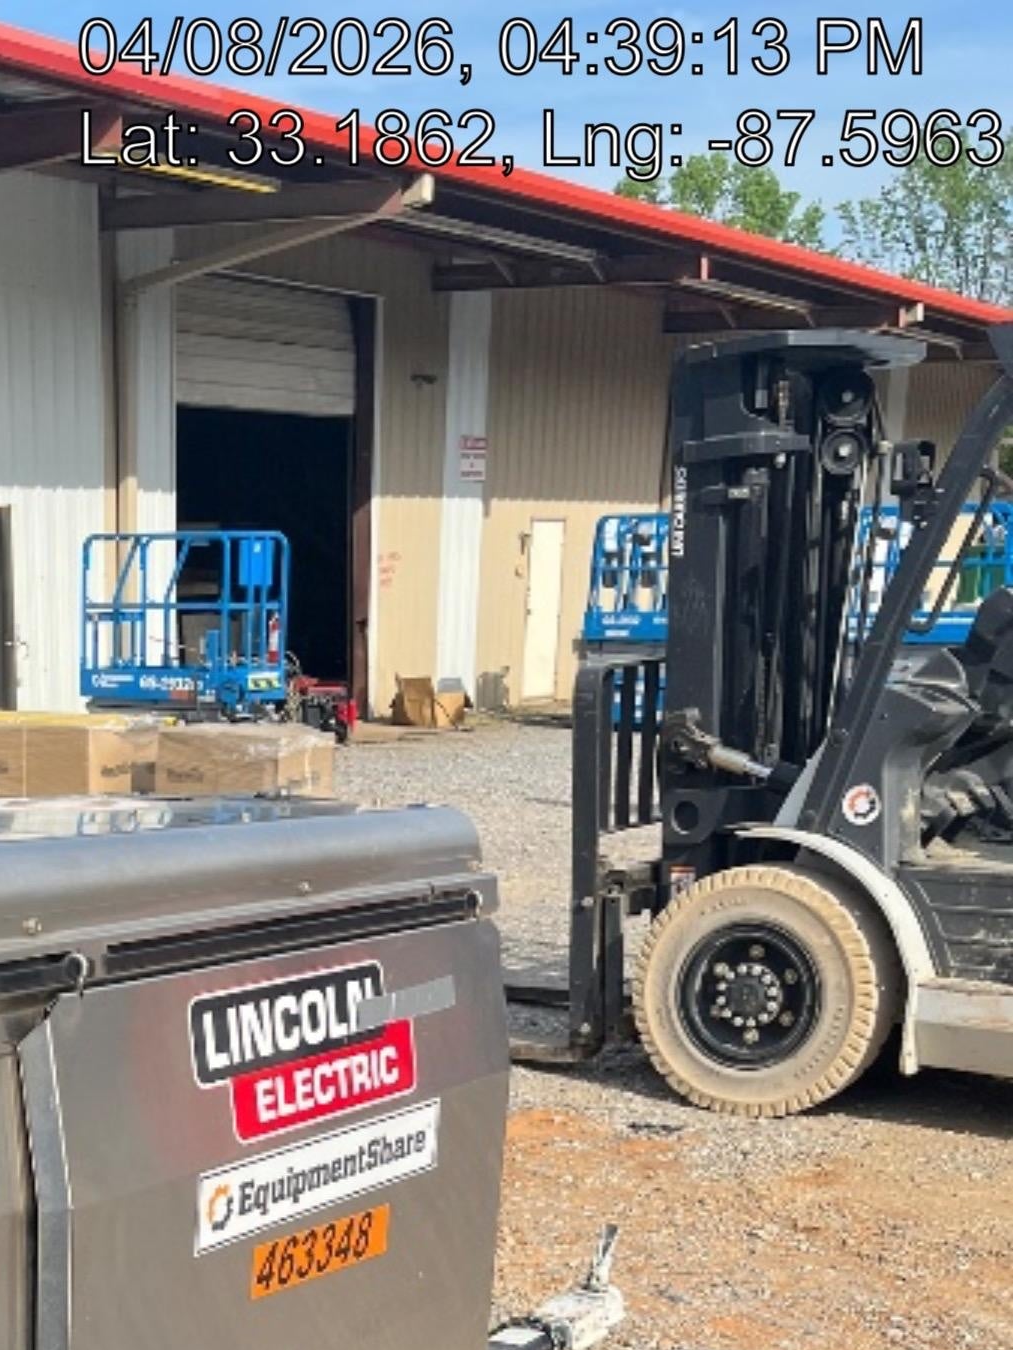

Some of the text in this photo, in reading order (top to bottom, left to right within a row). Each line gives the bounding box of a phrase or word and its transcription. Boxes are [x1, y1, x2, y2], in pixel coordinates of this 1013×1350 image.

[254, 1046, 399, 1123] ELECTRIC
[237, 1130, 426, 1217] EquipmentShare
[256, 1211, 373, 1290] 463348
